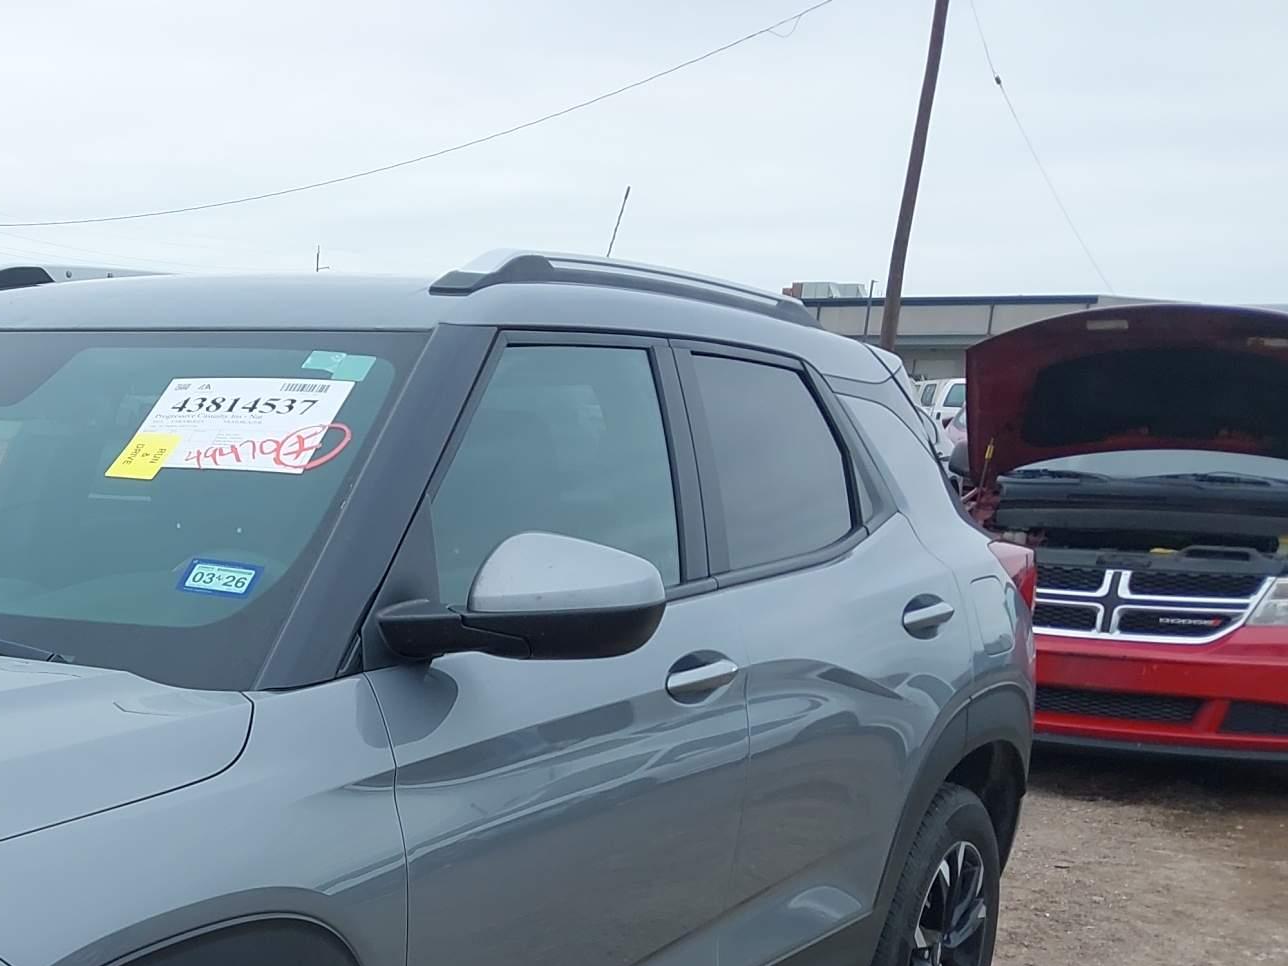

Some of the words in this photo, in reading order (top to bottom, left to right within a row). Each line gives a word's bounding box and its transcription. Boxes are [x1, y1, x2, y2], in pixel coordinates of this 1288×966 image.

[170, 396, 319, 415] 43814537
[122, 443, 145, 465] DRIVE
[149, 448, 167, 464] RUN
[192, 571, 216, 585] 03
[221, 575, 248, 589] 26
